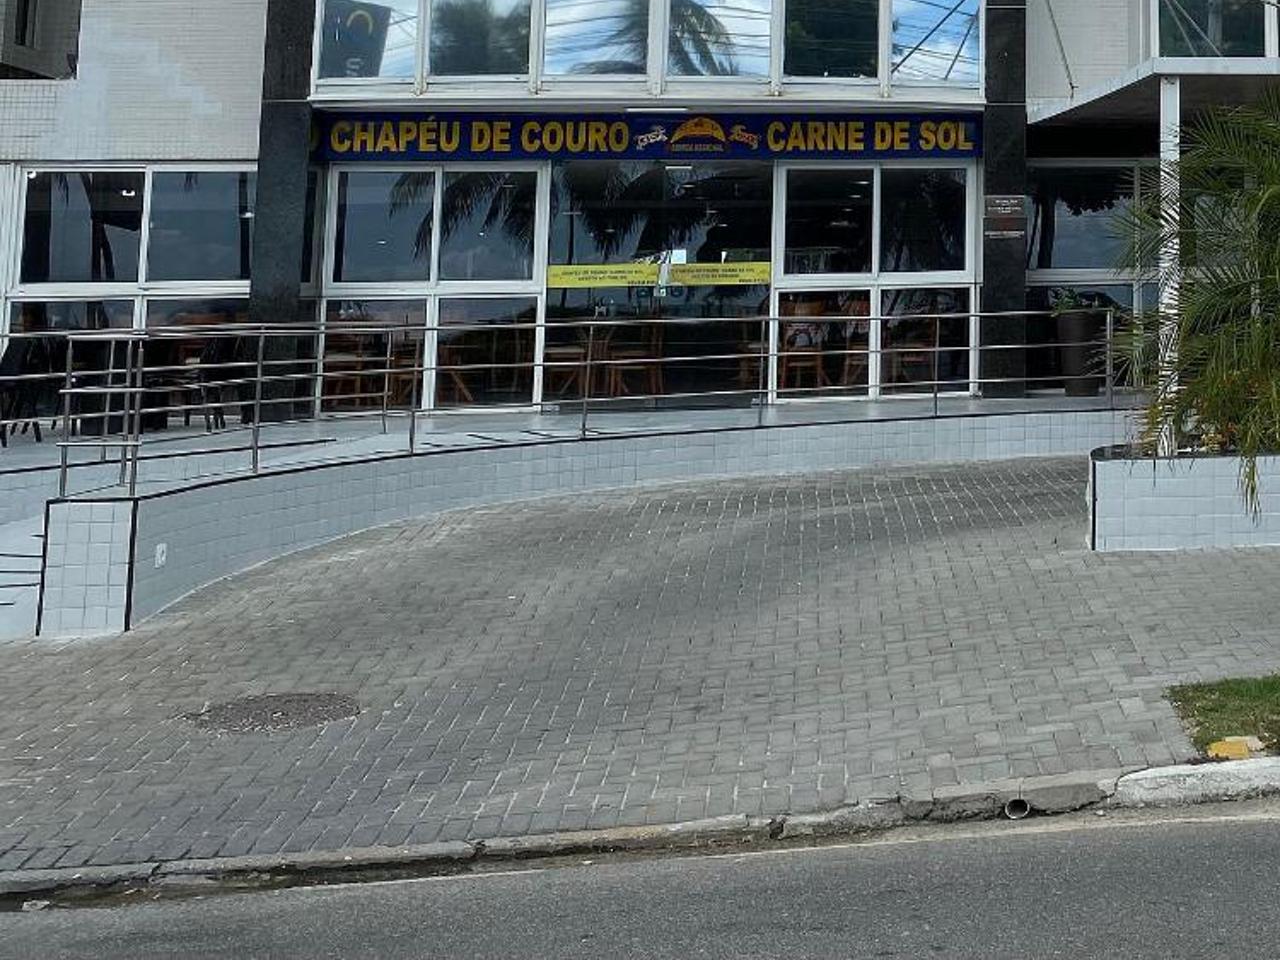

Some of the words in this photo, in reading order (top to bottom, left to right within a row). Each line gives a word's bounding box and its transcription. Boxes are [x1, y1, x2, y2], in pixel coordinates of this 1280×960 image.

[330, 116, 460, 152] CHAPÉU
[470, 121, 511, 152] DE
[520, 120, 629, 152] COURO
[767, 121, 865, 152] CARNE
[874, 121, 911, 151] DE
[918, 121, 974, 151] SOL
